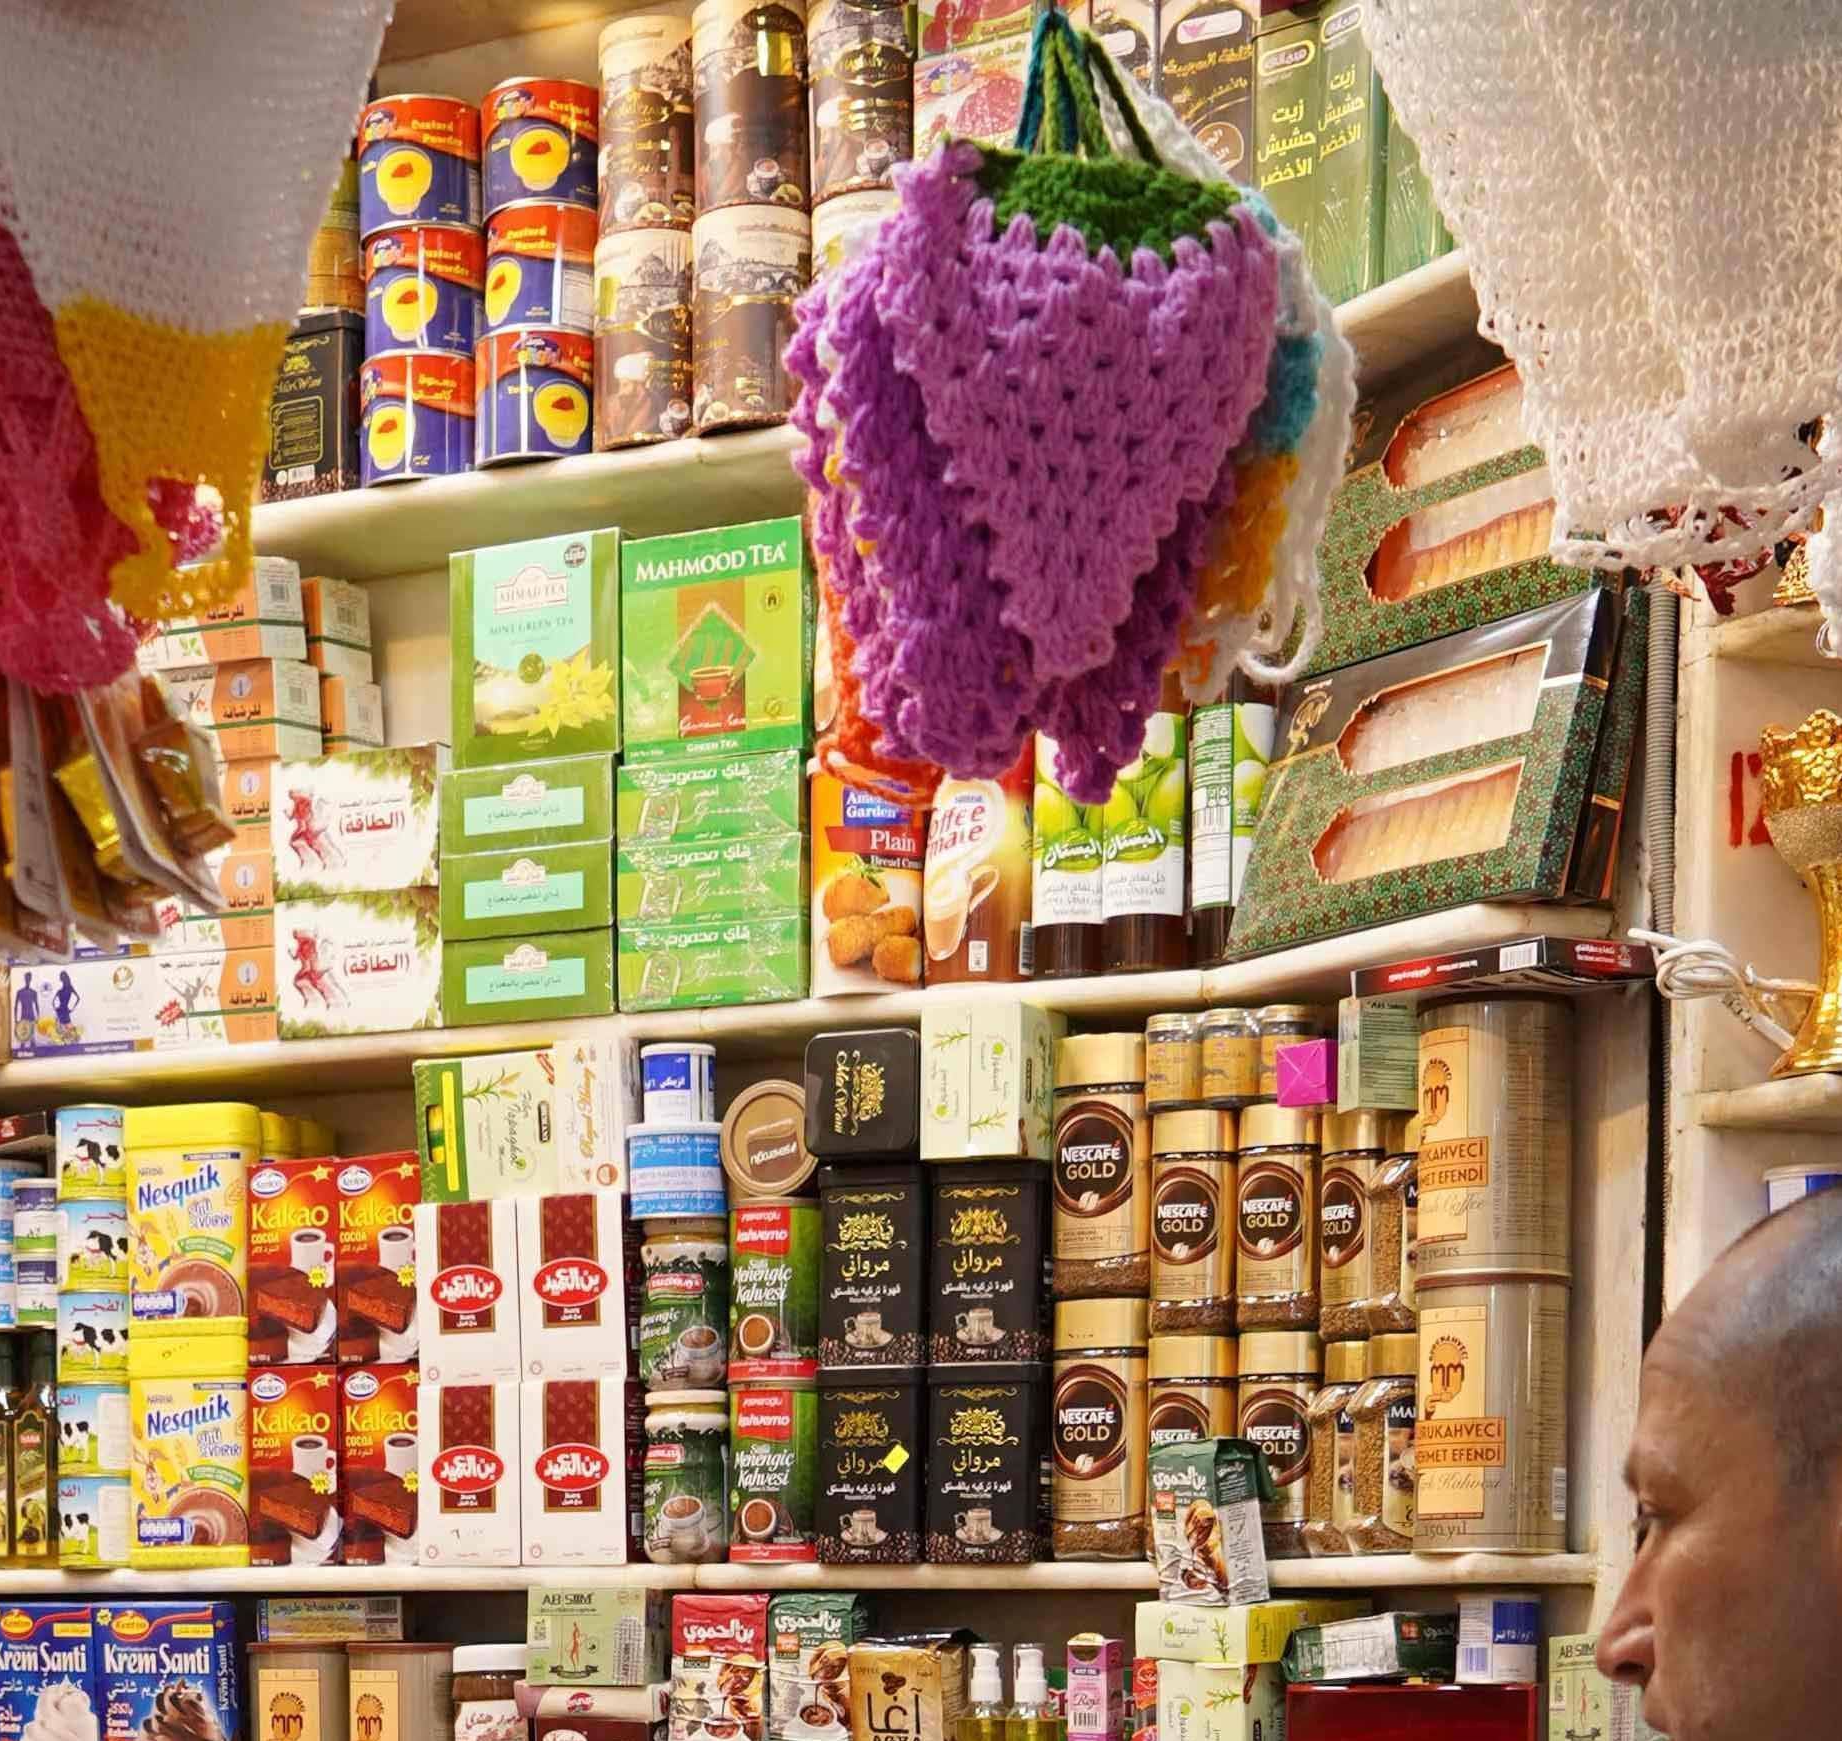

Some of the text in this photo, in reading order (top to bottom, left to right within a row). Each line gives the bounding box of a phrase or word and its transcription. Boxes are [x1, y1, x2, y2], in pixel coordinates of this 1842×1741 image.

[1272, 99, 1304, 124] زيت
[1257, 126, 1317, 163] حشيش
[635, 542, 786, 582] MAHMOOD TEA
[520, 621, 552, 632] GREEN
[846, 804, 897, 819] Garden
[929, 803, 987, 838] offee
[870, 831, 916, 853] Plain
[1062, 1139, 1121, 1163] NESCAFÉ
[1066, 1162, 1116, 1180] GOLD
[138, 1164, 222, 1211] Nesquik
[339, 1200, 414, 1229] Kakao
[1158, 1200, 1208, 1219] NESCAFÉ
[1242, 1193, 1293, 1214] NESCAFÉ
[252, 1201, 329, 1230] Kakao
[1161, 1219, 1204, 1233] GOLD
[1246, 1214, 1289, 1228] GOLD
[251, 1232, 279, 1245] COCOA
[339, 1231, 367, 1243] COCOA
[841, 1252, 890, 1280] مرواني
[952, 1249, 1003, 1278] مرواني
[737, 1281, 787, 1304] Kahvesi
[147, 1394, 232, 1439] Nesquik
[252, 1405, 330, 1435] Kakao
[345, 1404, 418, 1432] Kakao
[1059, 1403, 1116, 1425] NESCAFÉ
[252, 1437, 280, 1448] COCOA
[345, 1436, 373, 1447] COCOA
[1063, 1426, 1110, 1442] GOLD
[1247, 1421, 1302, 1441] NESCAFÉ
[952, 1449, 1001, 1478] مرواني
[738, 1468, 789, 1487] Kahvesi
[683, 1619, 738, 1643] الحموي
[774, 1611, 825, 1633] الحموي
[39, 1642, 87, 1678] Şanti
[105, 1643, 210, 1679] Krem Şanti
